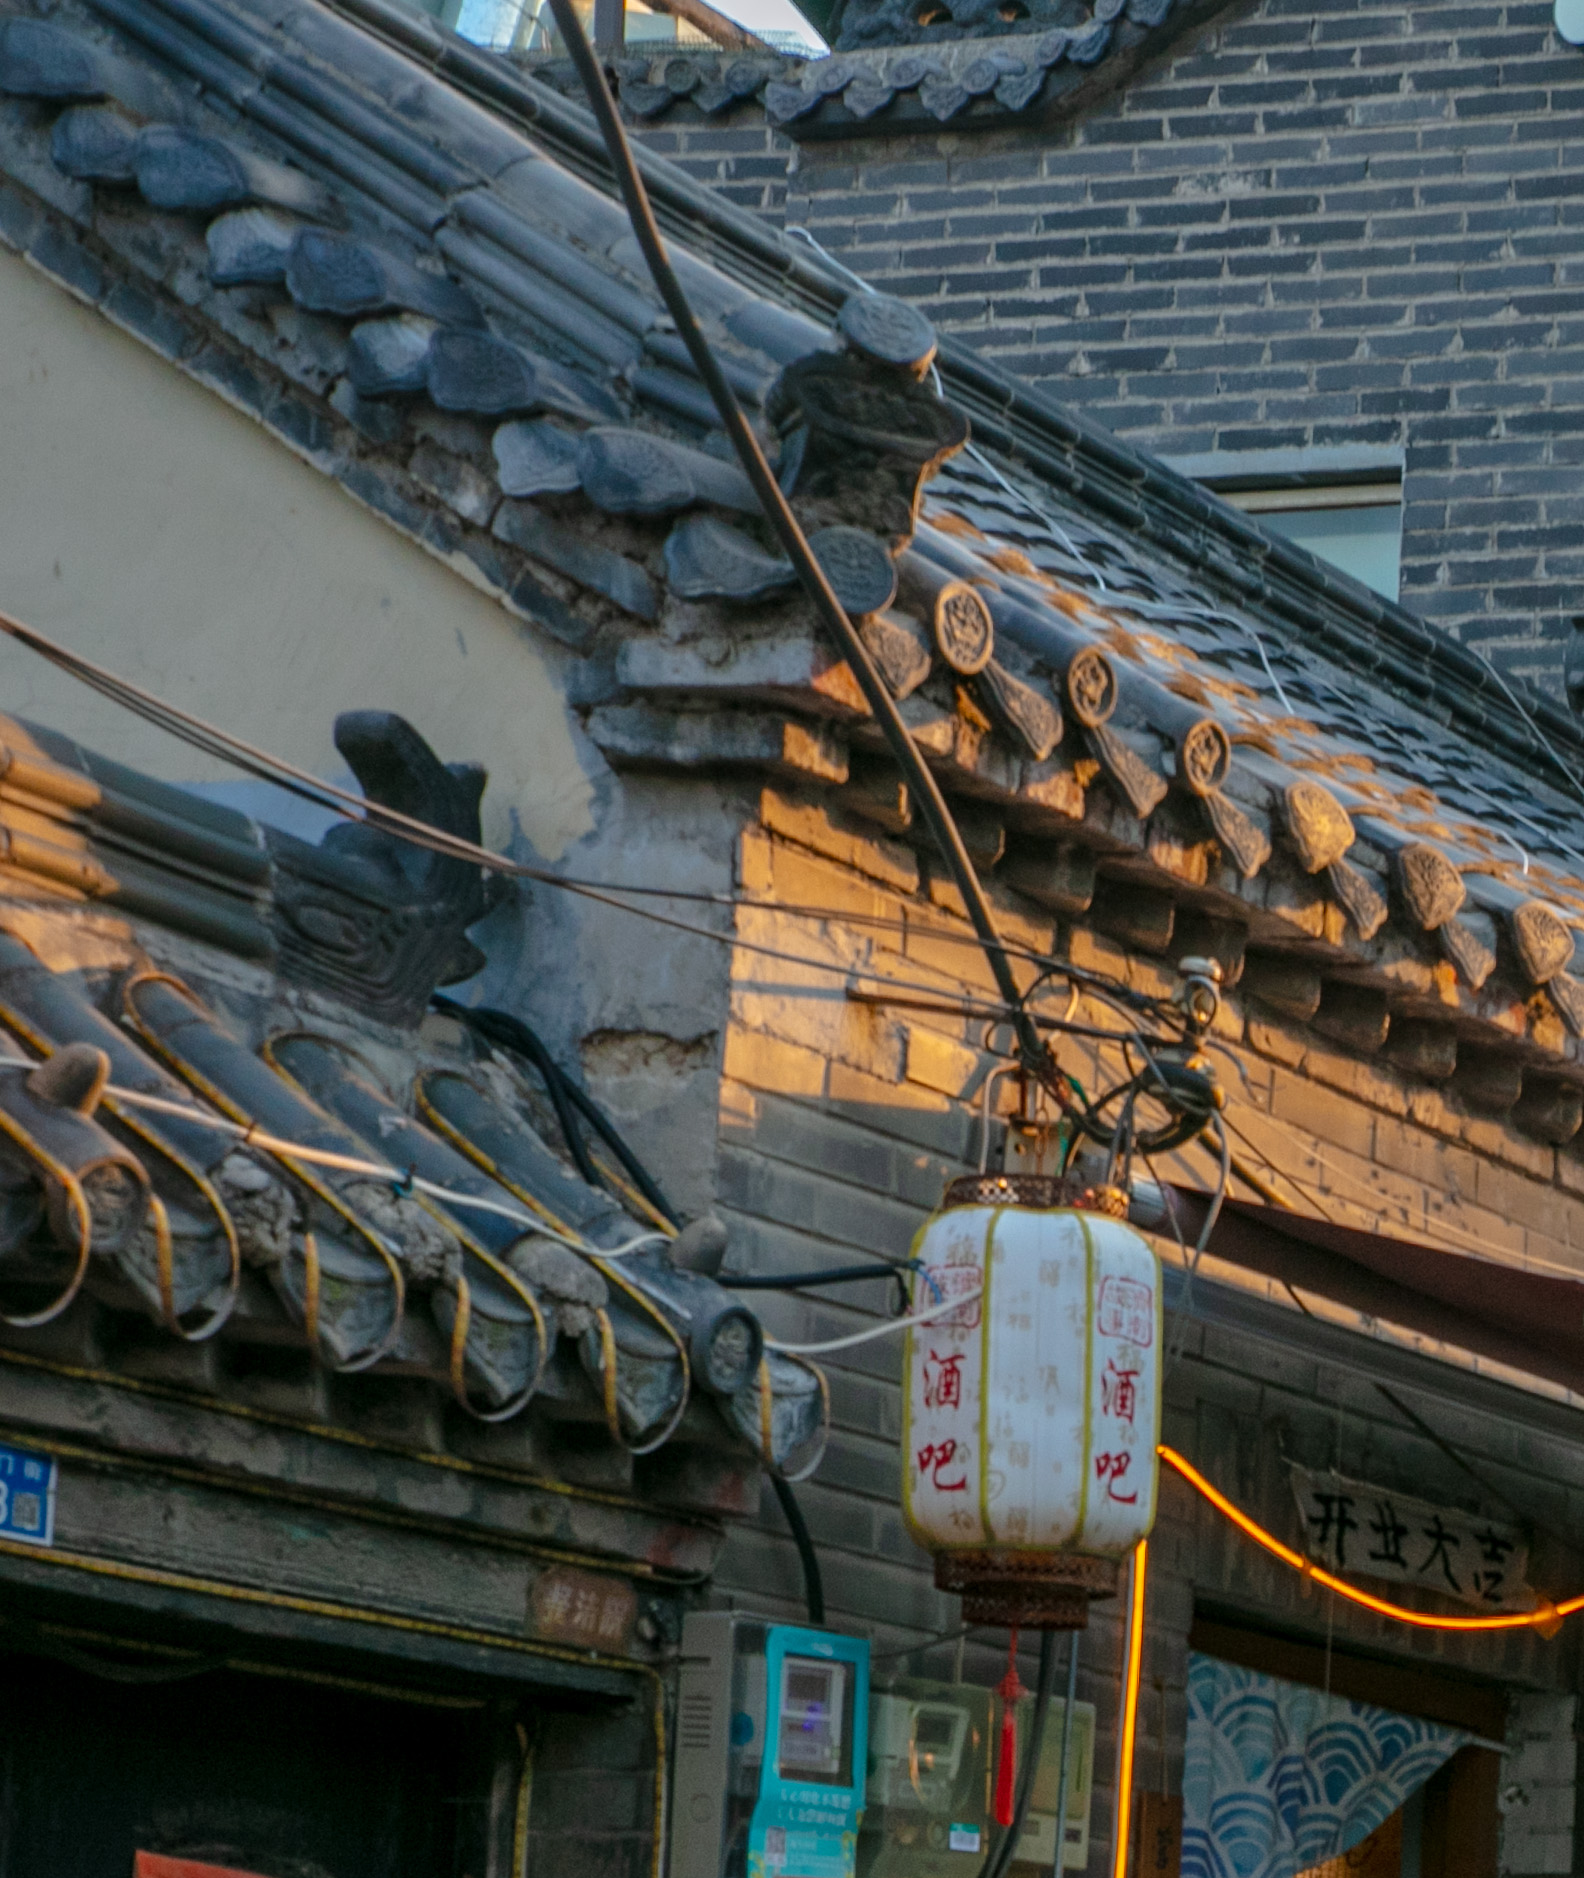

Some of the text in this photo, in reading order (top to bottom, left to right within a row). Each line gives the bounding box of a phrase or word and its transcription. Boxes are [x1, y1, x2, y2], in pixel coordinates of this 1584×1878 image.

[917, 1350, 967, 1491] 酒吧
[1095, 1358, 1140, 1504] 酒吧
[1308, 1493, 1515, 1602] 开业大吉
